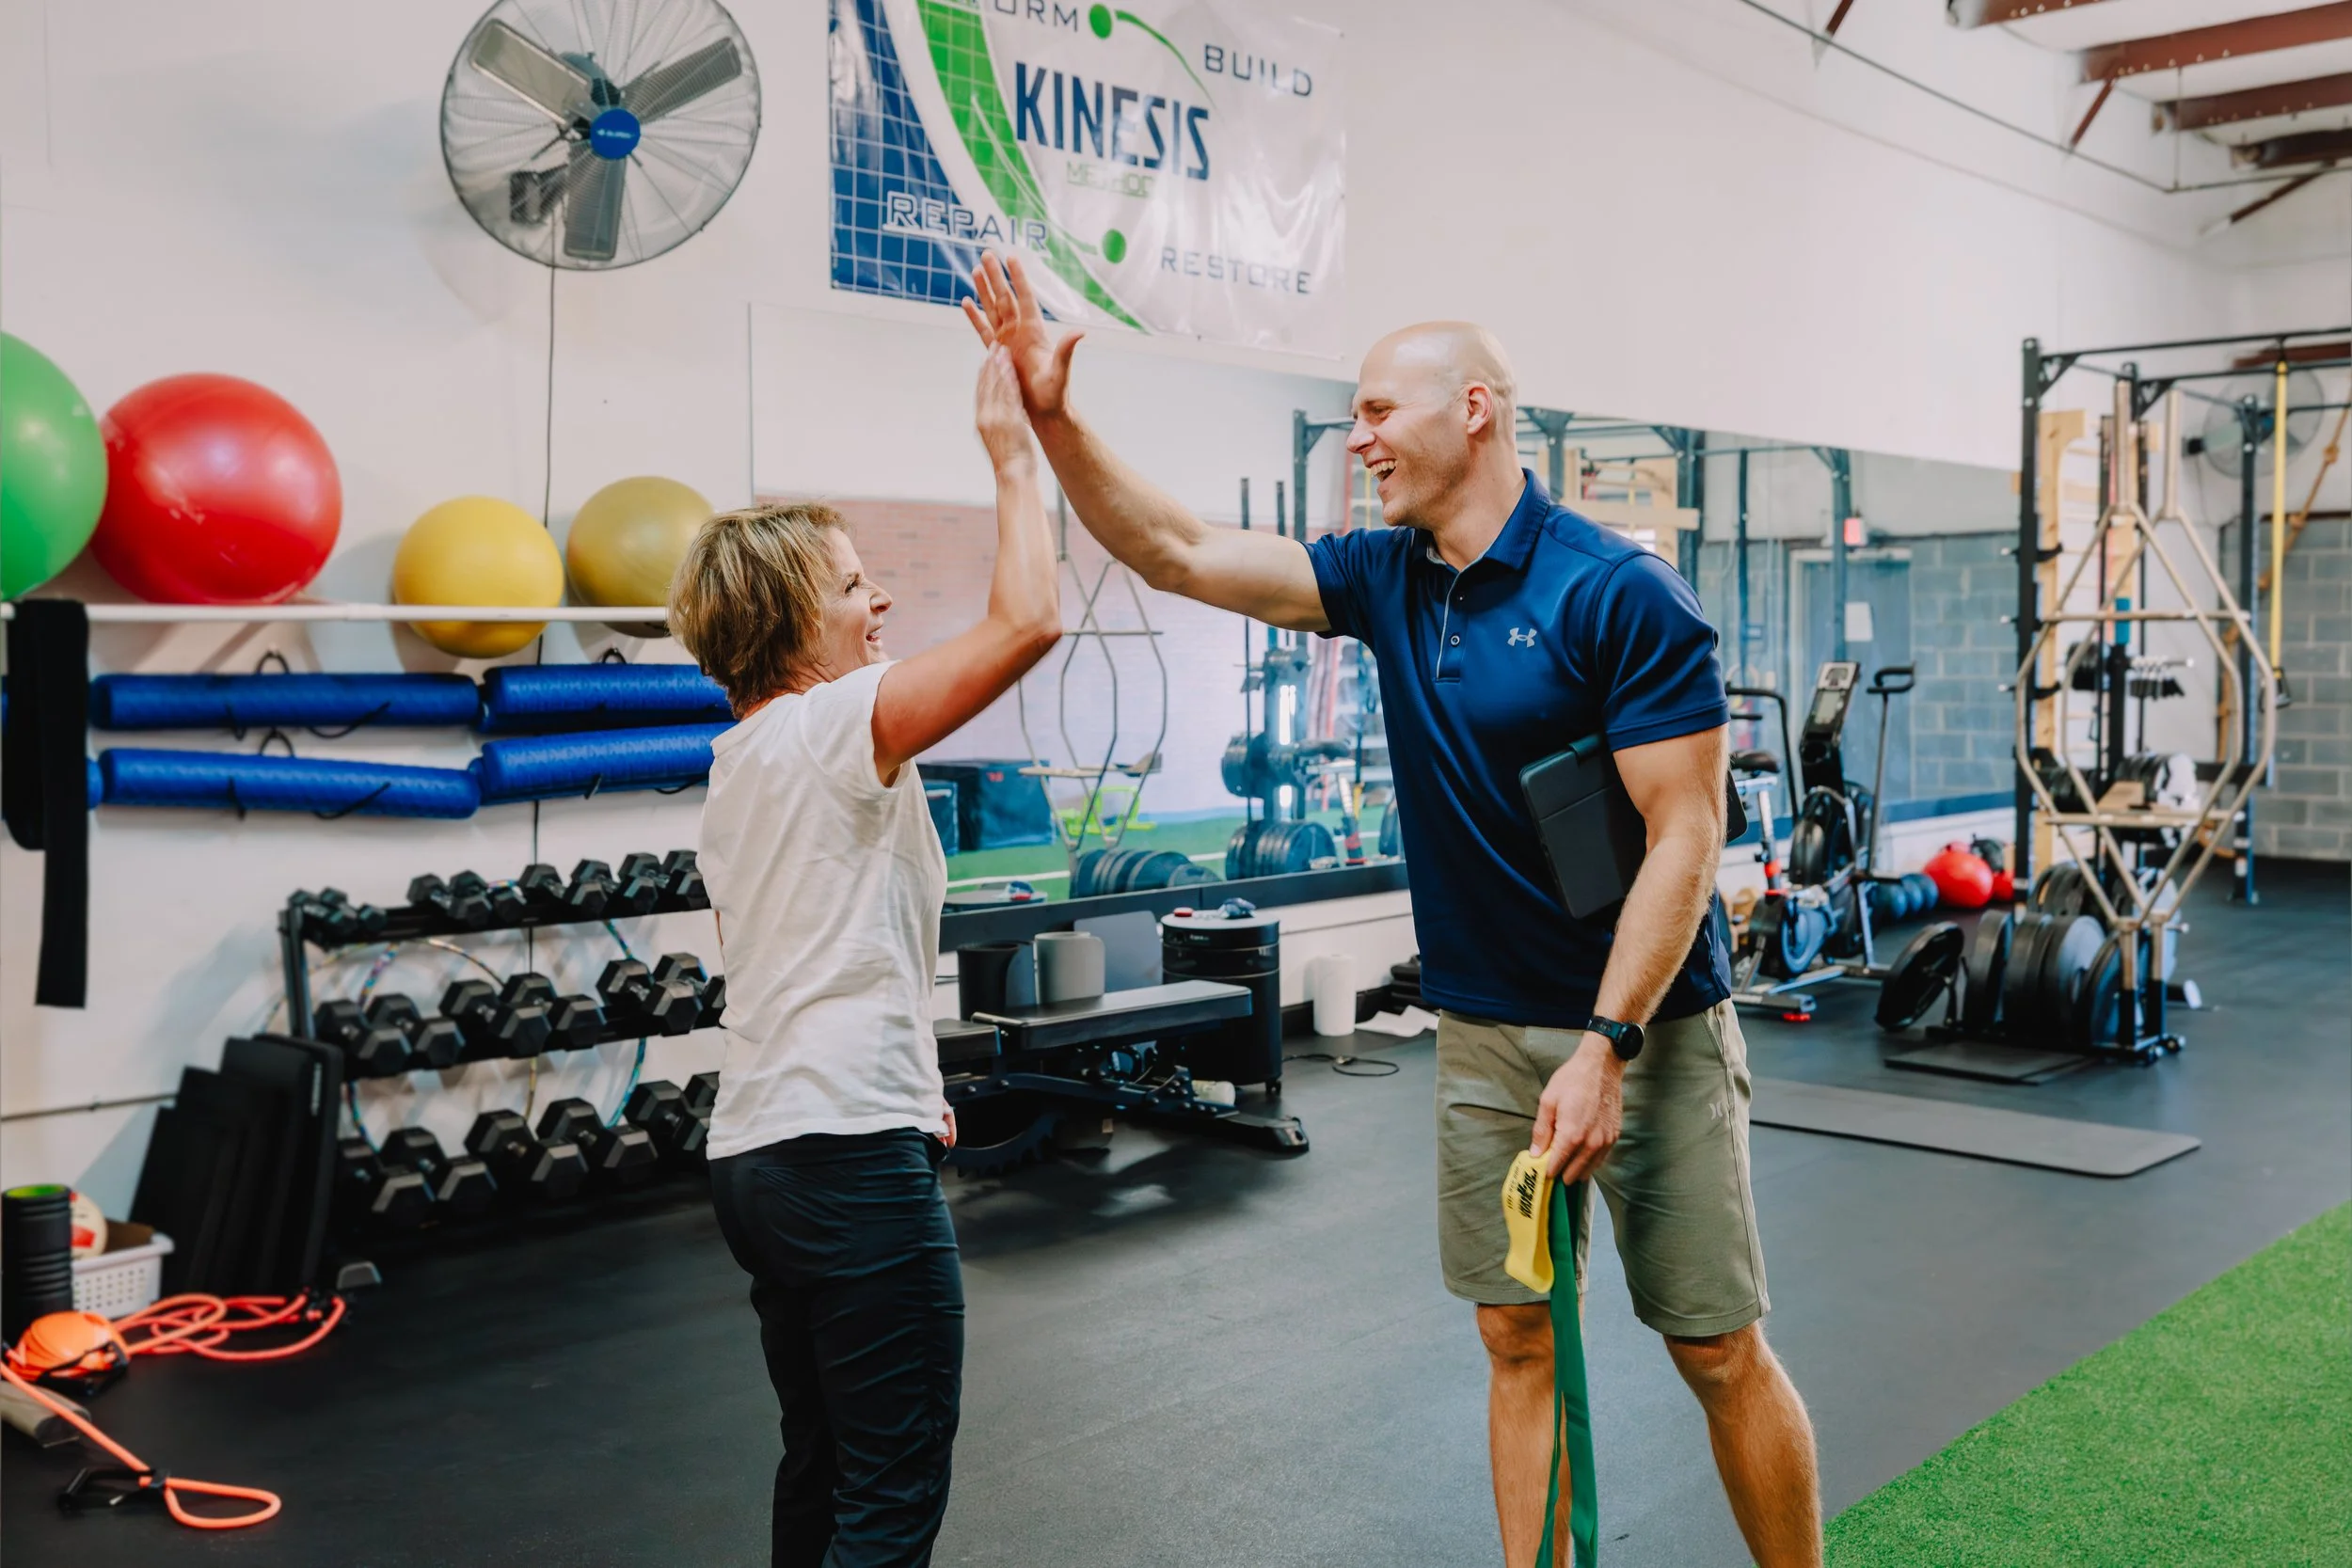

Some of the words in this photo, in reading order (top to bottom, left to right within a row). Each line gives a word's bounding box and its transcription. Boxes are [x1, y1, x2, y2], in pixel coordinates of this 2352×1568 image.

[972, 0, 1078, 32] ORM
[1204, 43, 1312, 97] BUILD
[1015, 61, 1210, 181] KINESIS
[886, 191, 1049, 251] REPAIR
[1160, 246, 1311, 294] RESTORE
